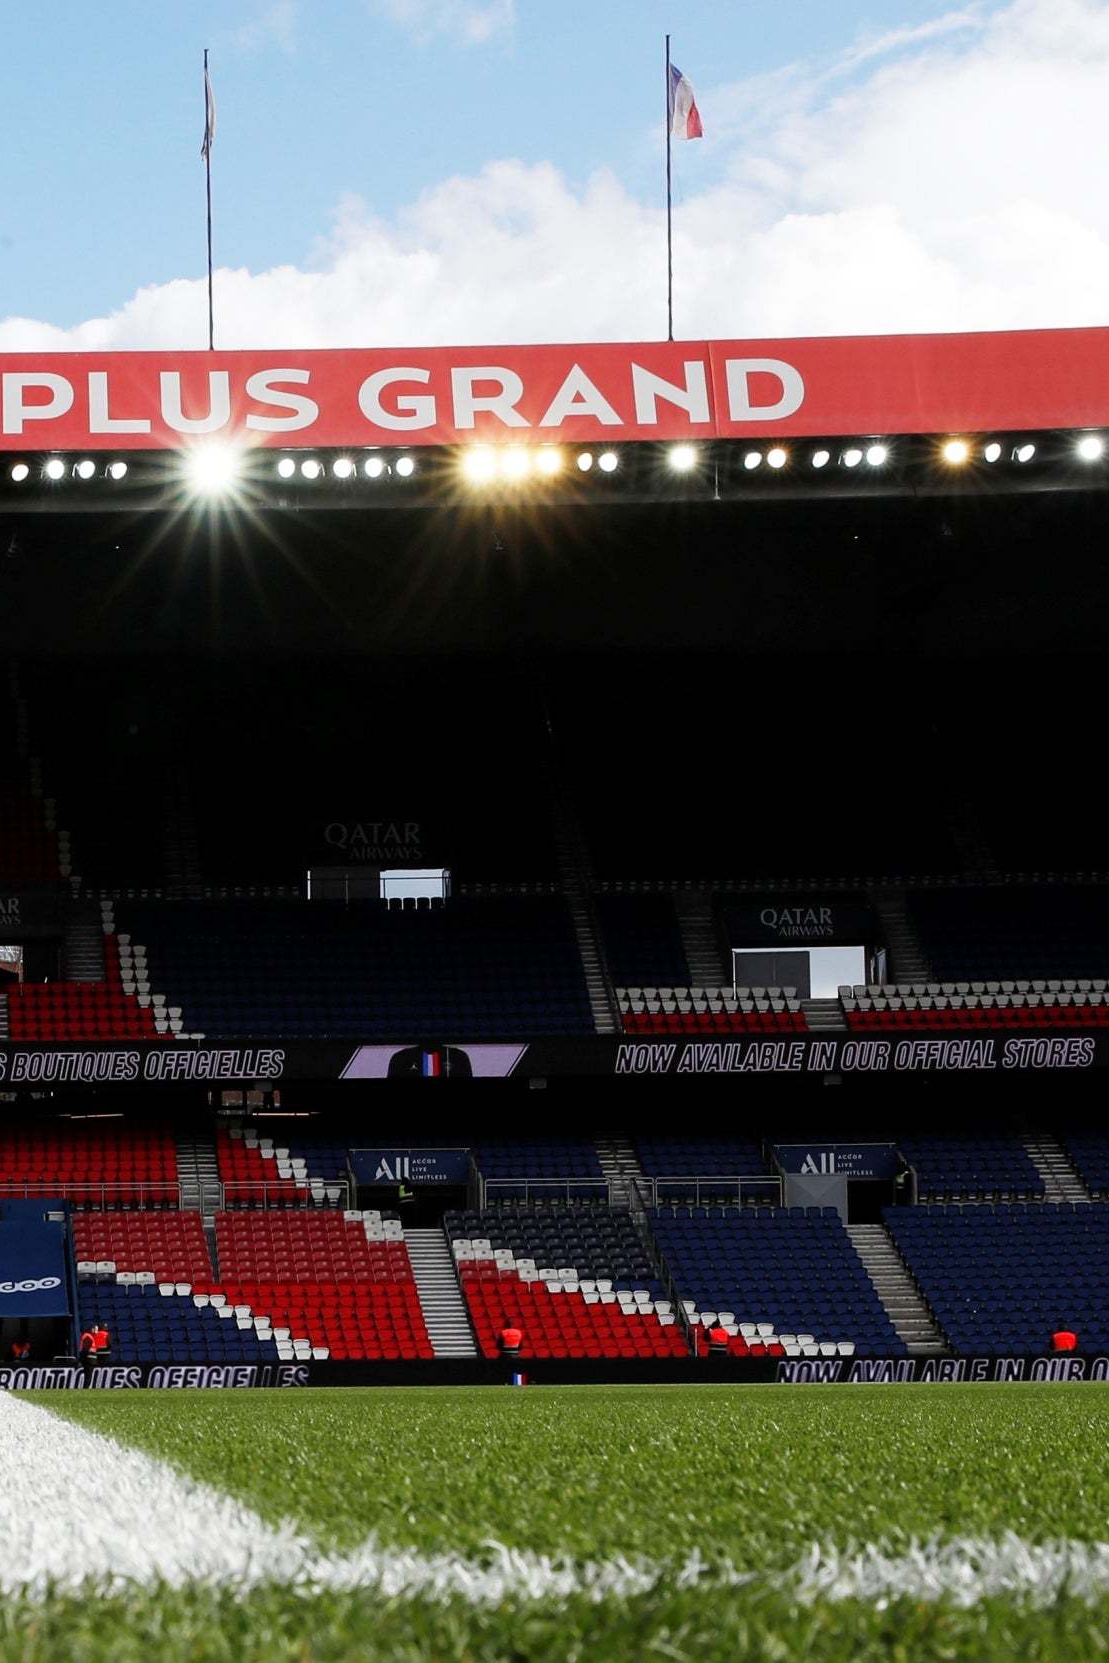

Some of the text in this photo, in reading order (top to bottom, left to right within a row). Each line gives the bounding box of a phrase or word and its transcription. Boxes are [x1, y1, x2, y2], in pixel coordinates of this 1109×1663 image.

[2, 368, 320, 434] PLUS
[358, 358, 805, 430] GRAND
[324, 823, 421, 849] QATAR
[760, 907, 833, 928] QATAR
[778, 926, 834, 937] AIRWAYS
[11, 1052, 139, 1082] BOUTIQUES
[144, 1050, 285, 1080] OFFICIELLES
[615, 1038, 1095, 1073] NOW AVAILABLE IN OUR OFFICIAL STORES
[147, 1366, 309, 1388] OFFICIELLES
[775, 1361, 842, 1383] NOW
[847, 1360, 988, 1383] AVAILABLE
[992, 1359, 1025, 1382] IN
[1028, 1358, 1085, 1381] OUR
